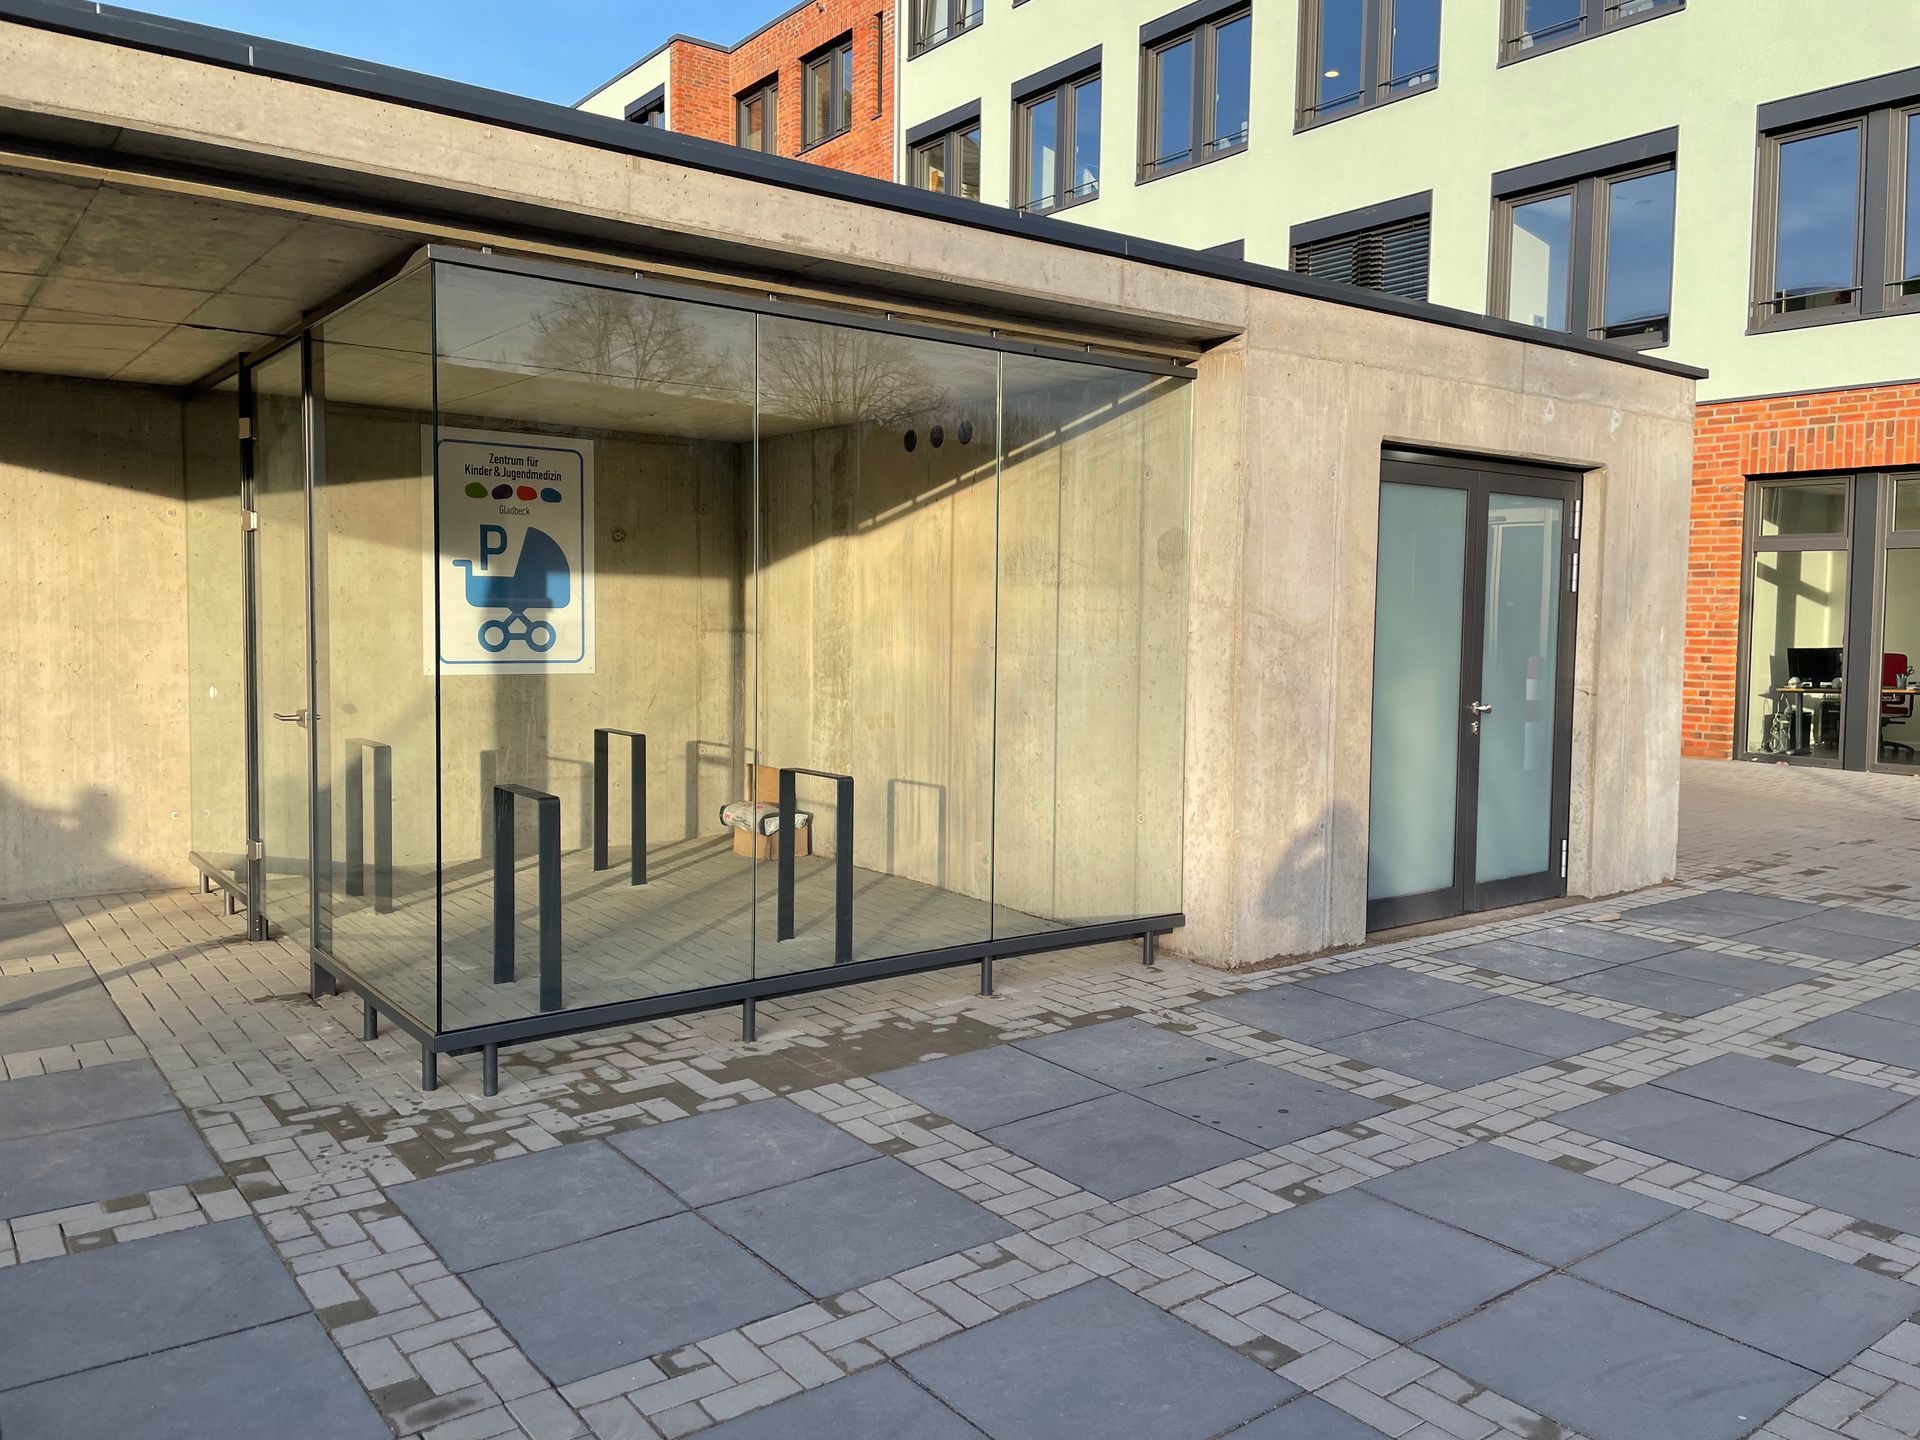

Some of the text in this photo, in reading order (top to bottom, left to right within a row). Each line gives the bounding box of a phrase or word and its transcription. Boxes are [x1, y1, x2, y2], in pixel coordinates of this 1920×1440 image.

[489, 453, 539, 467] Zentrum für
[464, 464, 562, 481] Kinder & Jugendmedizin
[499, 505, 530, 515] Gladbeck
[479, 524, 507, 570] P
